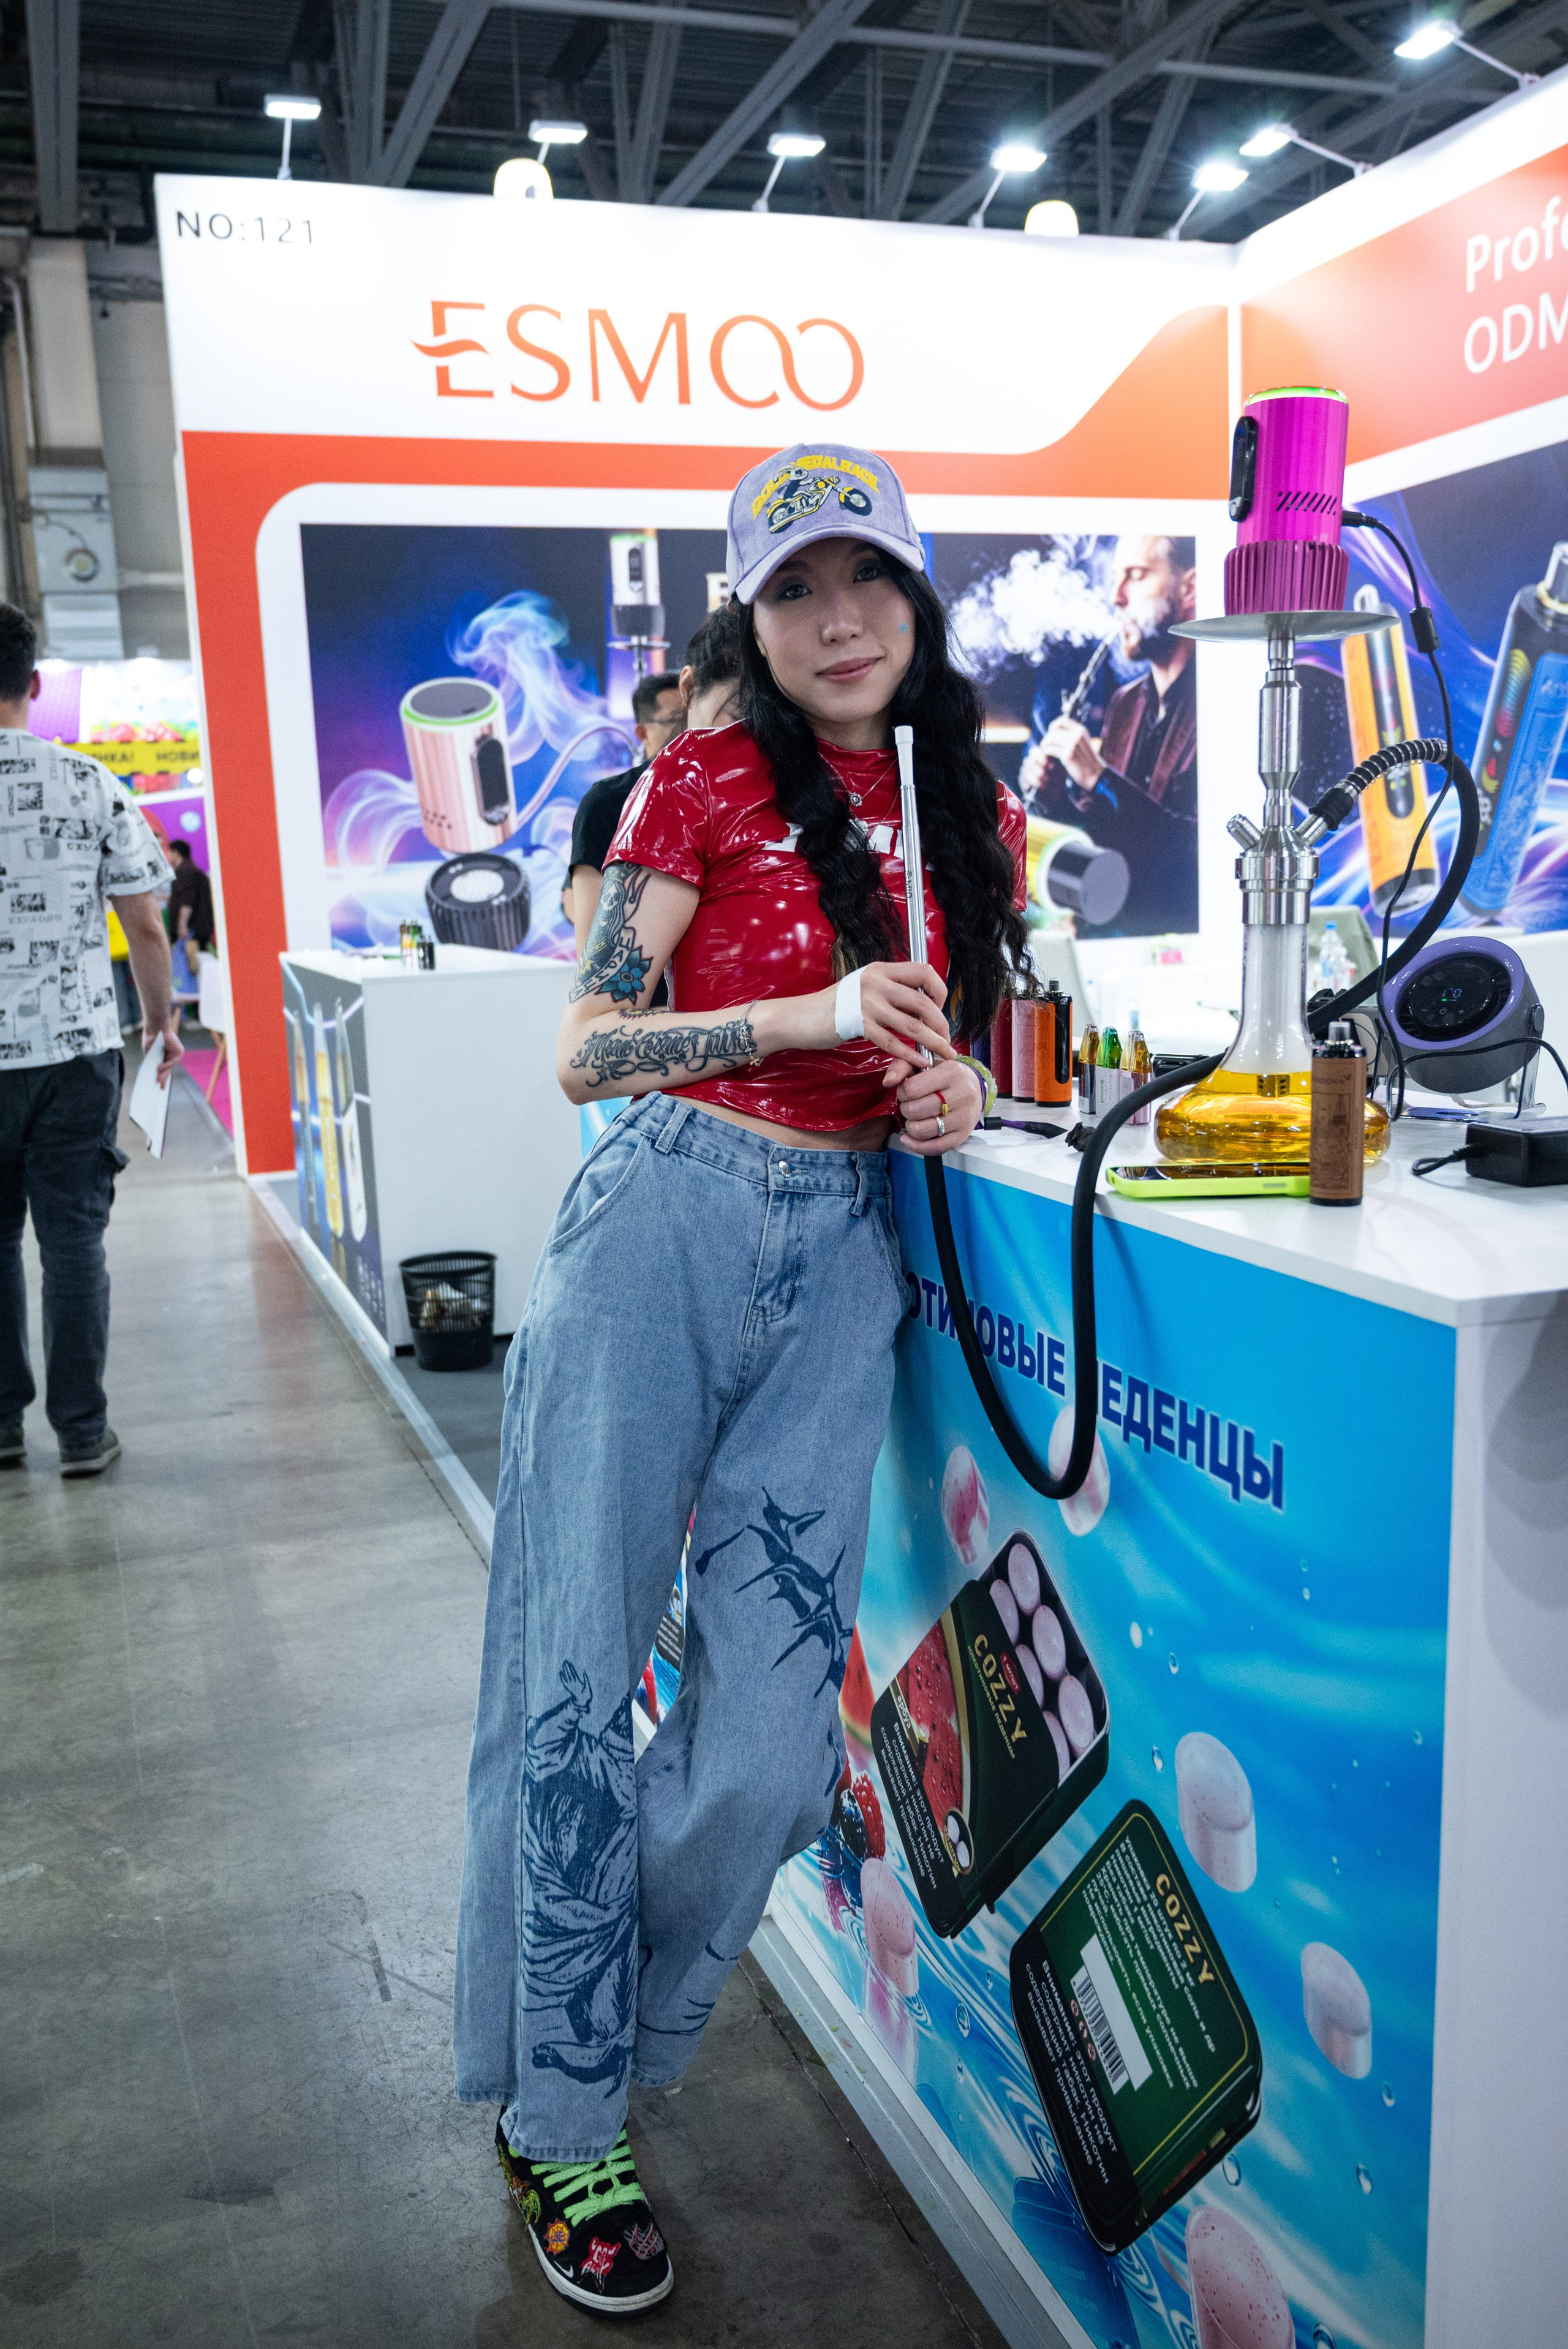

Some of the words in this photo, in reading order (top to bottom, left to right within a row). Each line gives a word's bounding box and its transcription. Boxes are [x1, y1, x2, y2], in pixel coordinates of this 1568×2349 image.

[176, 211, 311, 244] NO:121
[1466, 195, 1568, 293] Prof
[409, 301, 864, 412] ESMOO
[1442, 988, 1462, 998] 170
[902, 1268, 1065, 1398] ОТИОВЫЕ
[1096, 1358, 1283, 1512] ЕДЕНЦЫ
[897, 1695, 911, 1729] арбуз
[967, 1645, 996, 1711] НИКОТИНОВЫЕ
[994, 1712, 1016, 1759] ЛЕДЕНЦЫ
[974, 1634, 1027, 1743] COZZY
[881, 1727, 907, 1797] содержащий
[905, 1798, 918, 1833] табак.
[917, 1836, 937, 1889] Никотин
[881, 1748, 902, 1801] вызывает
[899, 1804, 925, 1877] привыкание
[892, 1739, 913, 1792] содержит
[911, 1794, 929, 1842] никотин
[927, 1843, 935, 1860] не
[894, 1722, 918, 1787] Внимание:
[916, 1788, 927, 1813] этот
[925, 1815, 944, 1863] продукт
[1105, 1860, 1117, 1883] Без
[1116, 1883, 1135, 1925] табака
[1110, 1853, 1134, 1904] Никотин
[1115, 1849, 1141, 1904] пищевые
[1120, 1842, 1126, 1853] В
[1125, 1854, 1148, 1901] составе
[1147, 1902, 1185, 1985] никотиновая
[1183, 1986, 1200, 2019] соль
[1156, 1874, 1215, 1983] COZZY
[1087, 1883, 1095, 1900] Не
[1132, 1992, 1147, 2024] если
[1145, 2025, 1174, 2088] упаковка
[1101, 1866, 1123, 1916] Хранить
[1123, 1917, 1135, 1942] при
[1134, 1942, 1171, 2025] температуре
[1170, 2027, 1179, 2044] не
[1178, 2046, 1198, 2087] выше
[1109, 1904, 1134, 1958] избегать
[1133, 1959, 1157, 2011] прямых
[1172, 1941, 1182, 1959] по
[1185, 1971, 1196, 1986] мг
[1026, 1963, 1063, 2058] содержащий
[1061, 2059, 1080, 2106] табак.
[1080, 2112, 1109, 2184] Никотин
[1027, 1991, 1057, 2062] вызывает
[1055, 2067, 1093, 2165] привыкание
[1041, 1981, 1071, 2051] содержит
[1069, 2056, 1095, 2121] никотин
[1094, 2124, 1104, 2145] не
[1042, 1959, 1077, 2046] Внимание:
[1076, 2049, 1091, 2083] этот
[1090, 2087, 1117, 2151] продукт
